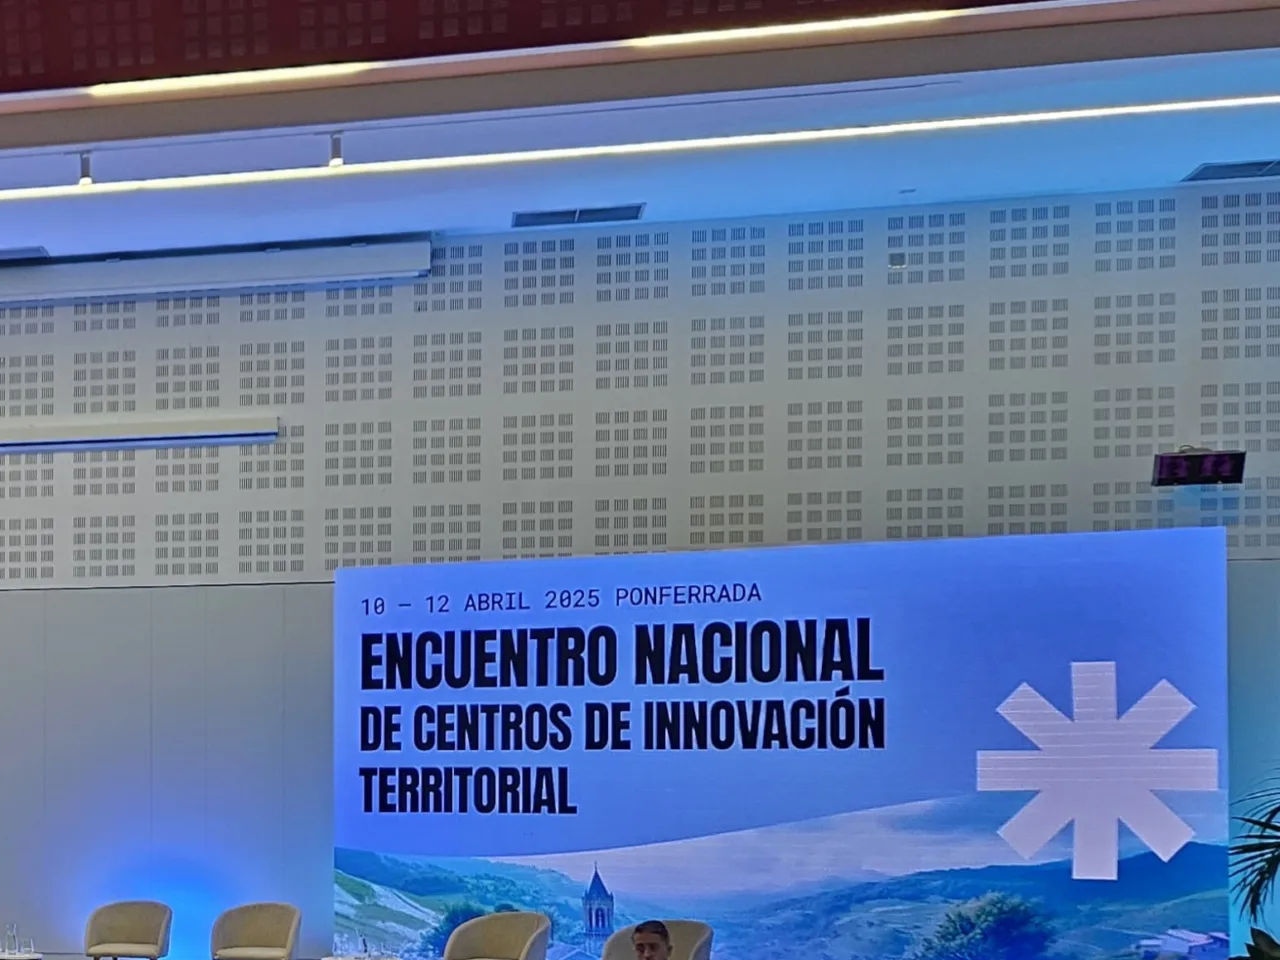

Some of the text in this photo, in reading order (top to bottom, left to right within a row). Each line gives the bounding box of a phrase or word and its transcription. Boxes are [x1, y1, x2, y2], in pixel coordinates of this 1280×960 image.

[361, 597, 385, 615] 10
[426, 595, 450, 613] 12
[464, 592, 531, 612] ABRIL
[545, 590, 600, 609] 2025
[615, 582, 762, 606] PONFERRADA
[361, 617, 885, 690] ENCUENTRO NACIONAL
[360, 685, 885, 751] DE CENTROS DE INNOVACIÓN
[359, 766, 578, 814] TERRITORIAL
